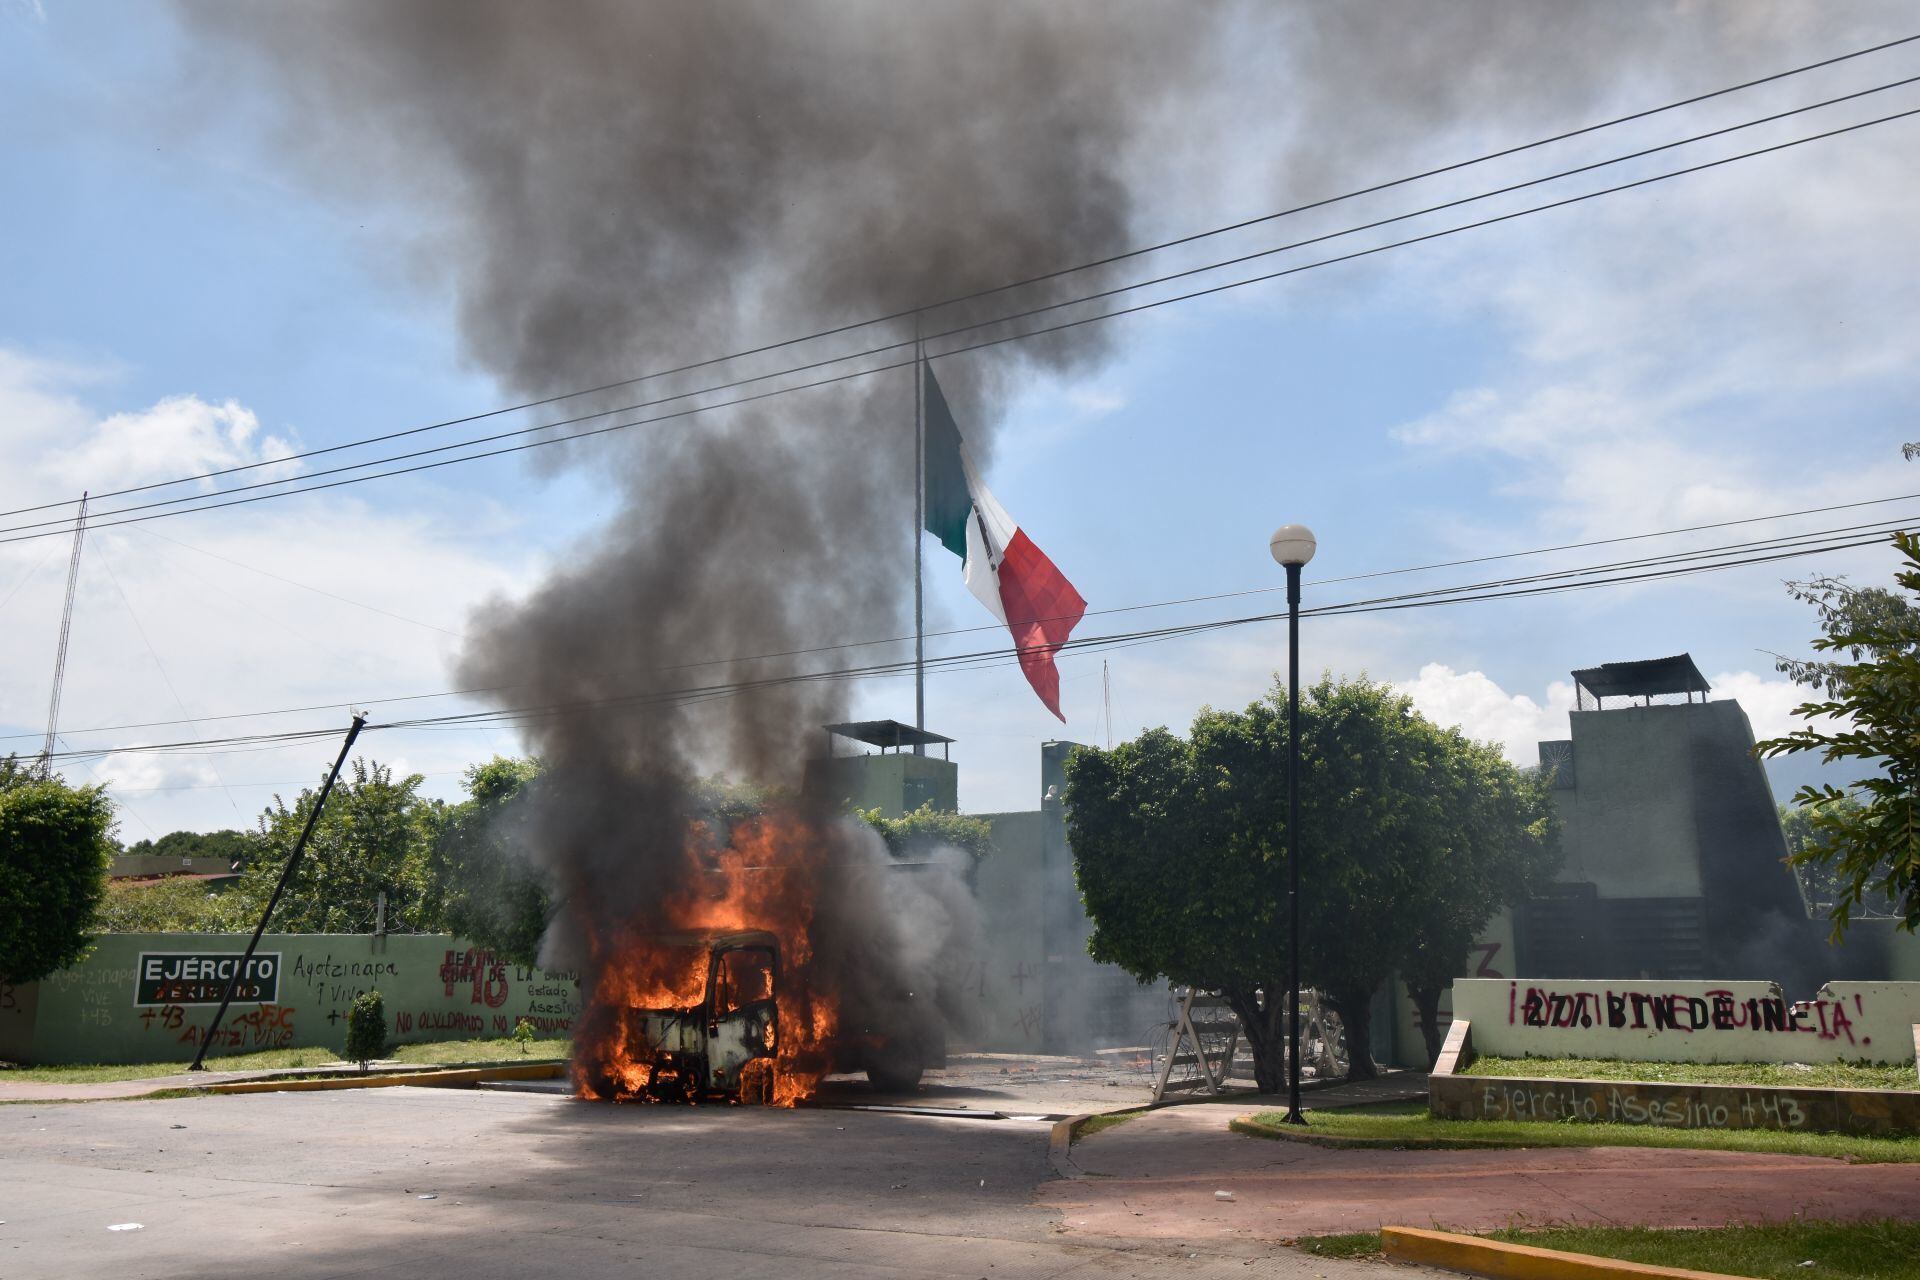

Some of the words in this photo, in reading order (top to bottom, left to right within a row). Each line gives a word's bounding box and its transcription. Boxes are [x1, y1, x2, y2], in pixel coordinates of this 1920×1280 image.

[145, 957, 274, 981] EJÉRCITO
[294, 954, 399, 986] Ayotzinapa
[528, 983, 568, 998] Estado
[396, 1011, 413, 1034] NO
[493, 1014, 508, 1032] NO
[1482, 1086, 1598, 1118] Ejercito
[1608, 1087, 1729, 1128] Asesino
